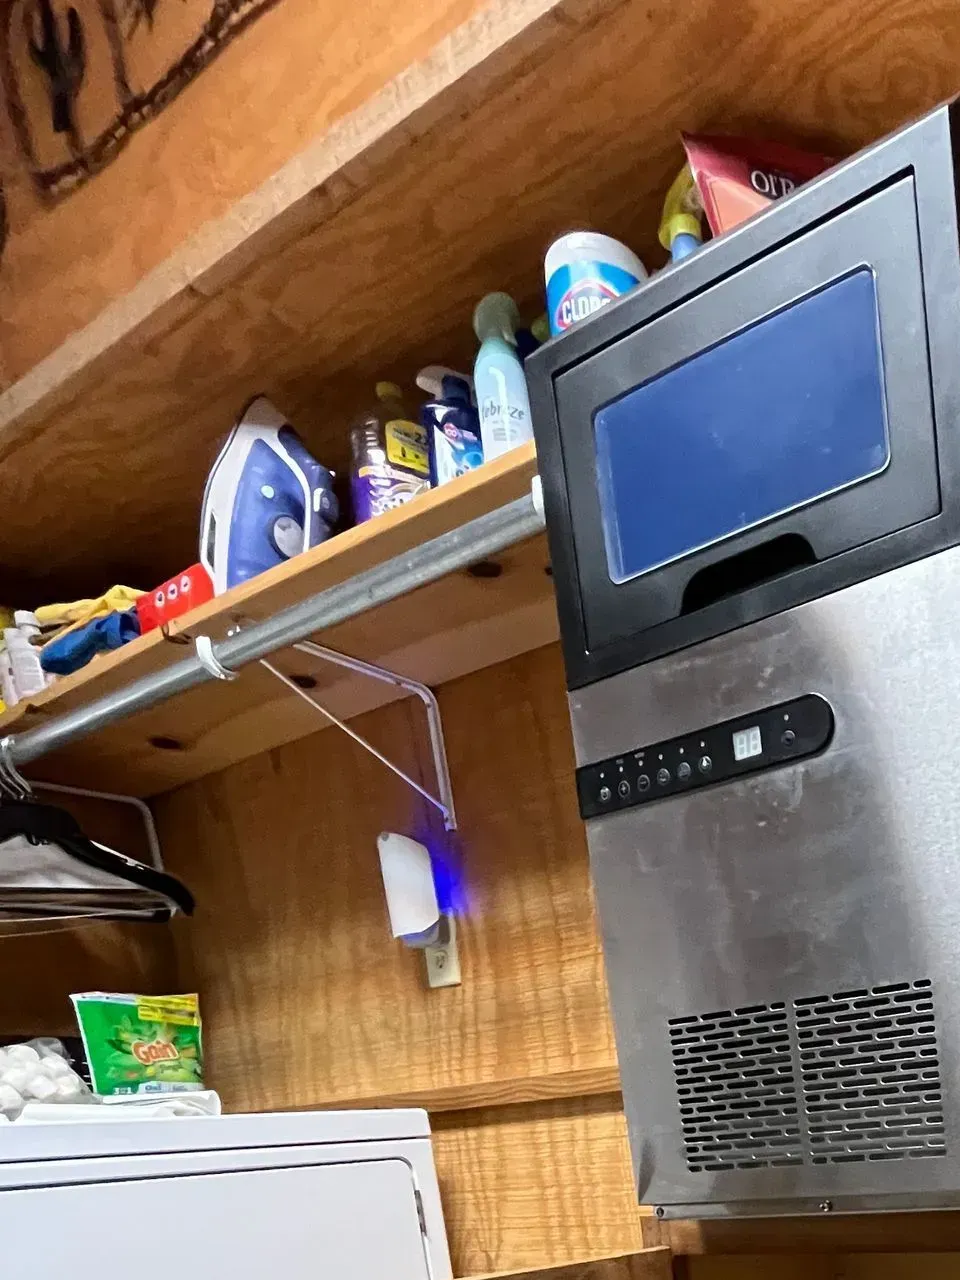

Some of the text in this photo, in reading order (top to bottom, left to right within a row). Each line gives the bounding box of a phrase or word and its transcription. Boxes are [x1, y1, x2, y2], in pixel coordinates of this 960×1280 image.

[562, 295, 611, 325] CLOR
[481, 399, 525, 424] febrze
[132, 1040, 178, 1065] Gain
